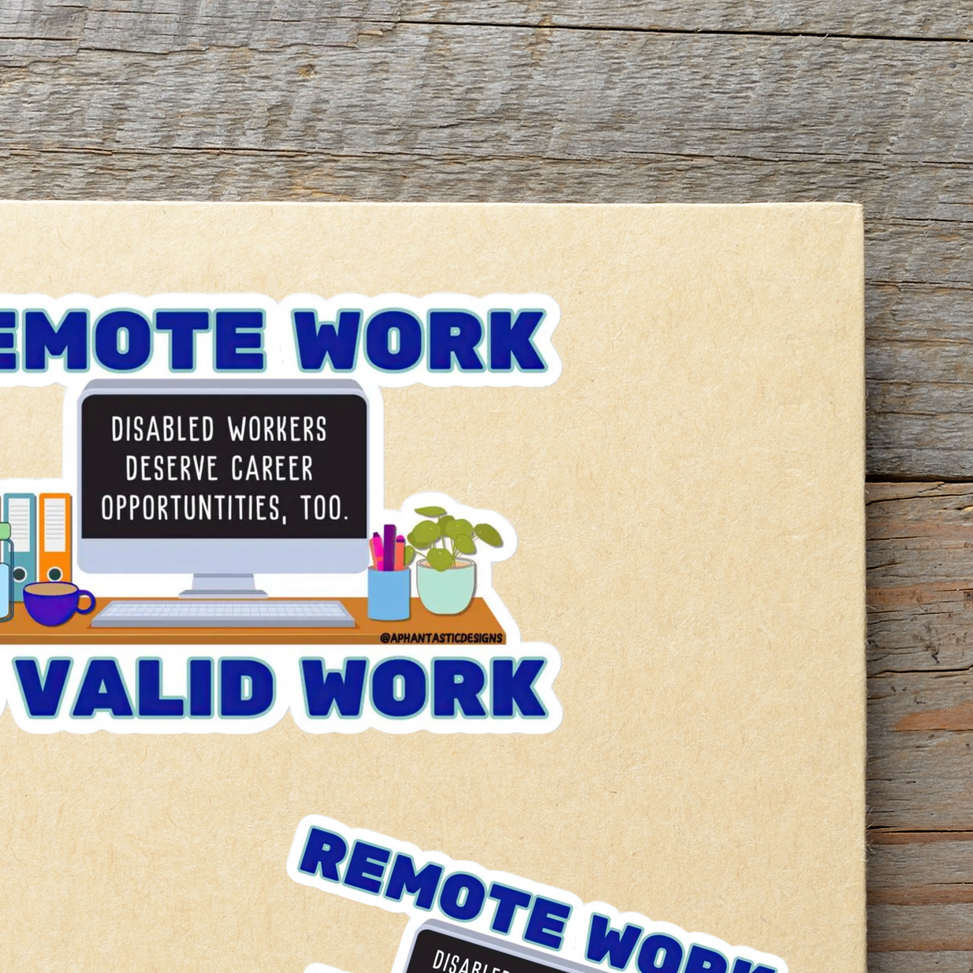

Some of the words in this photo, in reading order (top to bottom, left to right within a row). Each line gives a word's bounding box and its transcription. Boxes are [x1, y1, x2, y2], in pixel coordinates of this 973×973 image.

[291, 307, 548, 374] WORK
[111, 415, 214, 442] DISABLED
[227, 415, 327, 442] WORKERS
[126, 454, 218, 481] DESERVE
[231, 454, 313, 481] CAREER
[101, 494, 287, 525] OPPORTUNTITIES,
[300, 494, 348, 520] TOO.
[380, 633, 502, 643] @APHANTASTICDESIGNS
[12, 656, 276, 720] VALID
[298, 656, 549, 720] WORK
[297, 825, 573, 952] REMOTE
